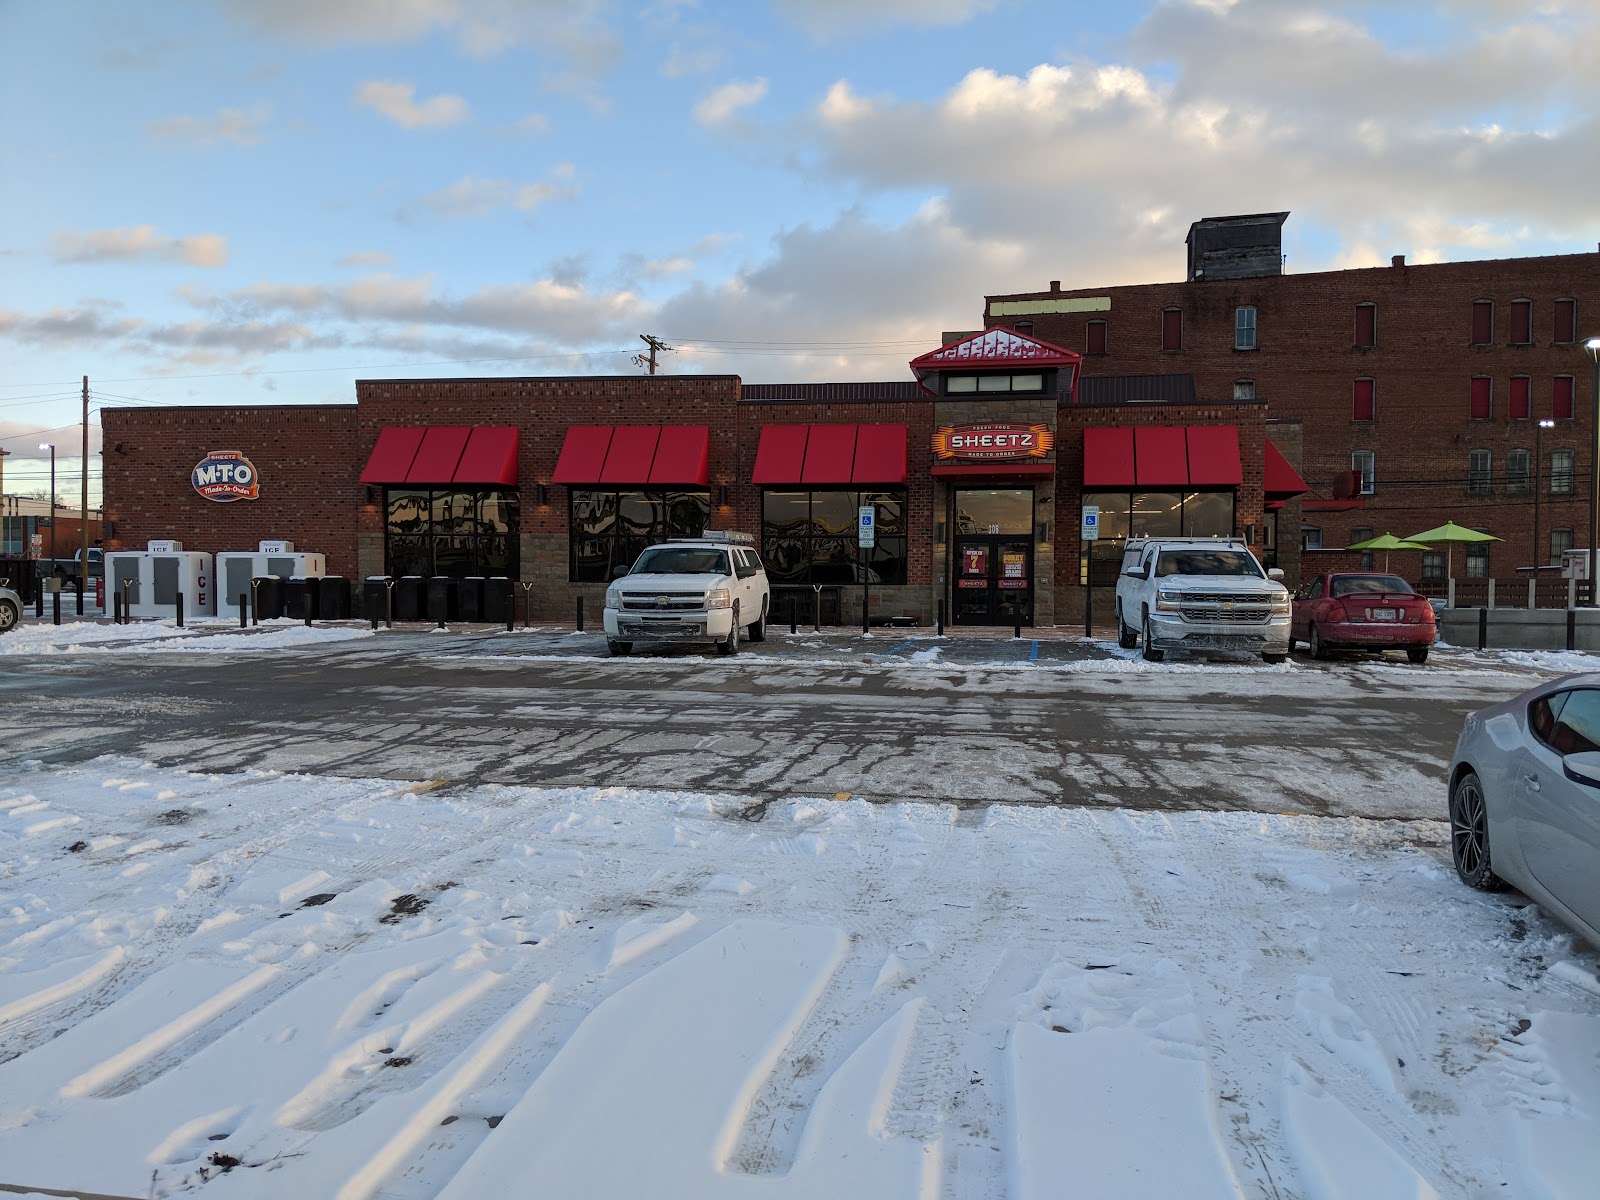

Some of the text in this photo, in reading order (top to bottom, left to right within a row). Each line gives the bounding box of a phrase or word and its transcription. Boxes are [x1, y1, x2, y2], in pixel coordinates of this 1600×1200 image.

[952, 434, 1033, 447] SHEETZ
[970, 555, 979, 569] 7
[198, 558, 206, 606] ICE
